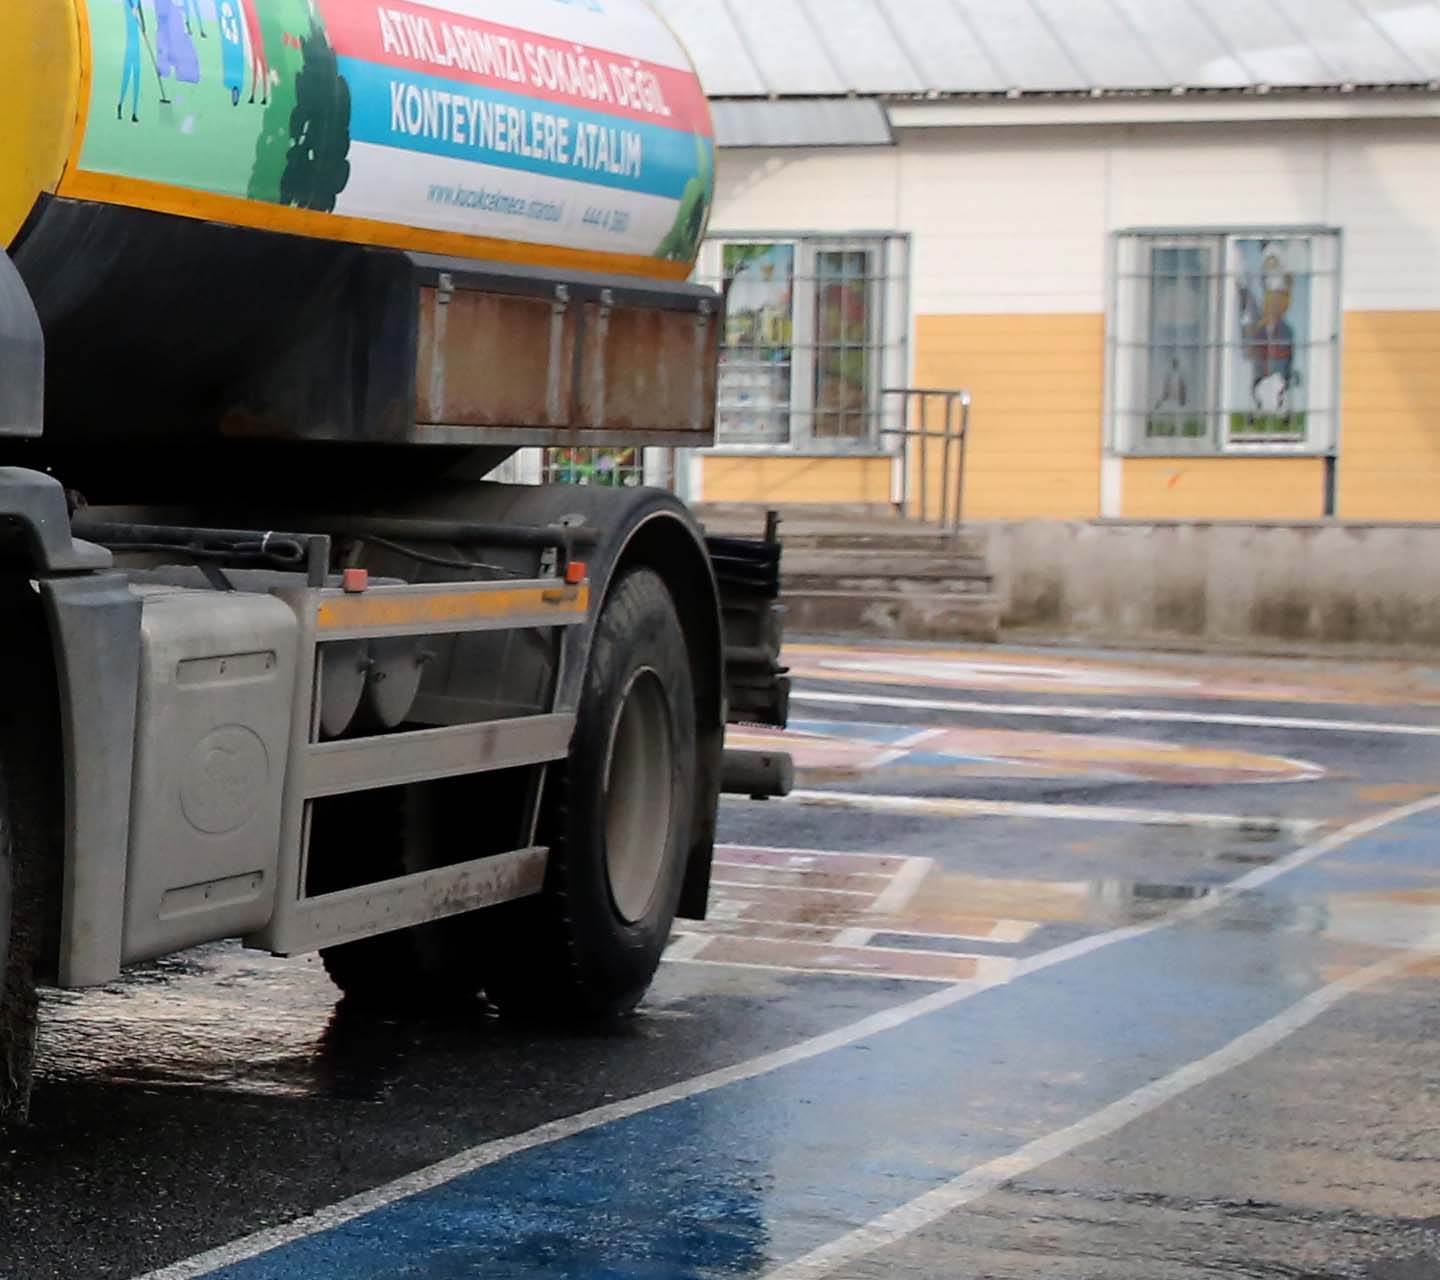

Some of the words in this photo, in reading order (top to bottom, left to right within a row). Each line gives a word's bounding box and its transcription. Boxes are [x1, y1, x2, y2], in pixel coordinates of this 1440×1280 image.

[377, 6, 527, 84] ATIKLARIMIZI
[523, 43, 614, 104] SOKAĞA
[609, 60, 673, 117] DEĞİL
[389, 80, 570, 164] KONTEYNERLERE
[572, 120, 643, 179] ATALIM
